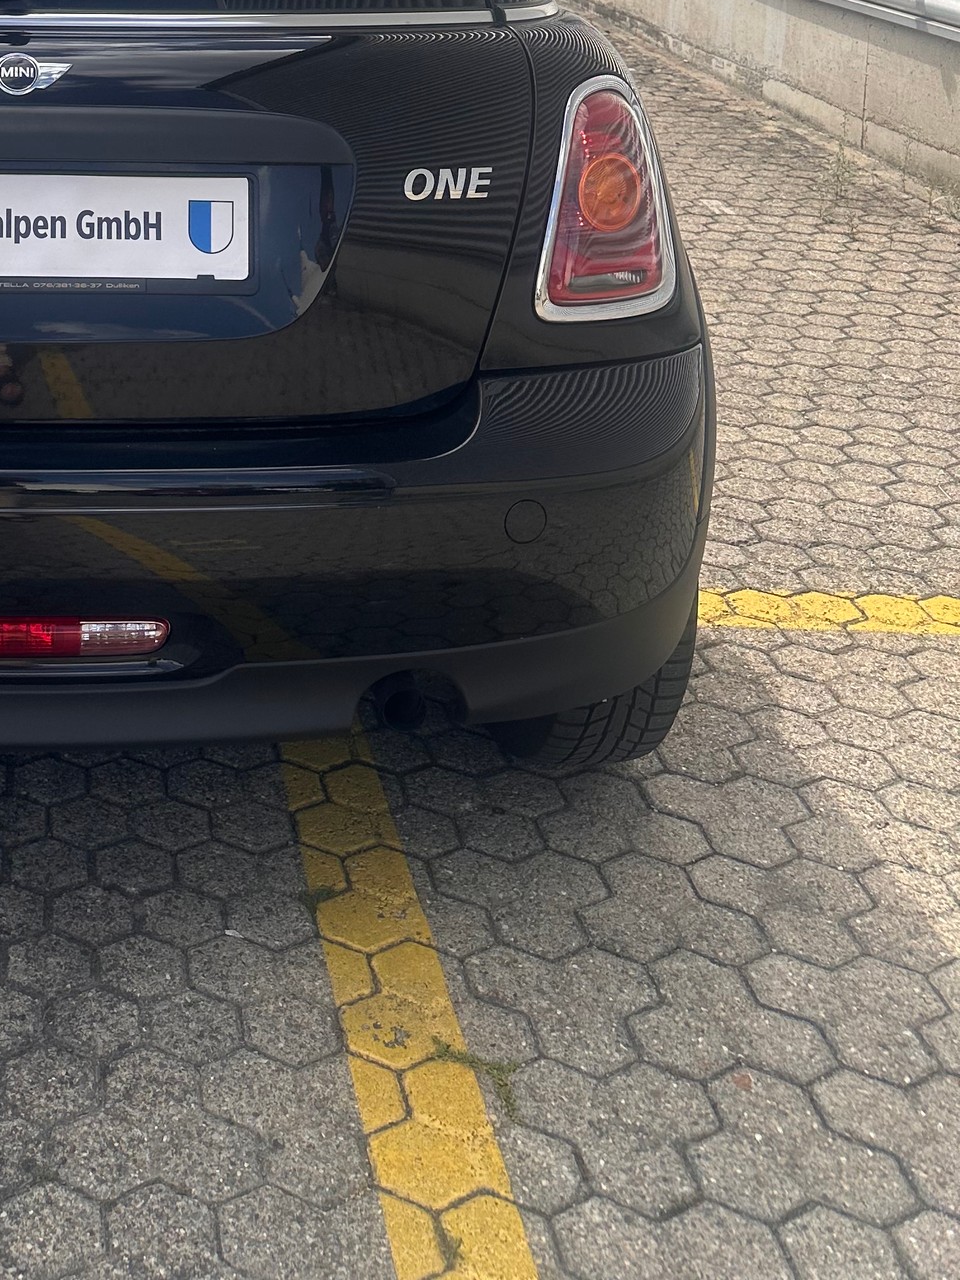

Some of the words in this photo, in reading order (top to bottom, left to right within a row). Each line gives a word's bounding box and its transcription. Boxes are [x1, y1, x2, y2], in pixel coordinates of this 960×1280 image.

[0, 66, 34, 78] MINI
[404, 166, 493, 201] ONE
[76, 209, 162, 241] GmbH
